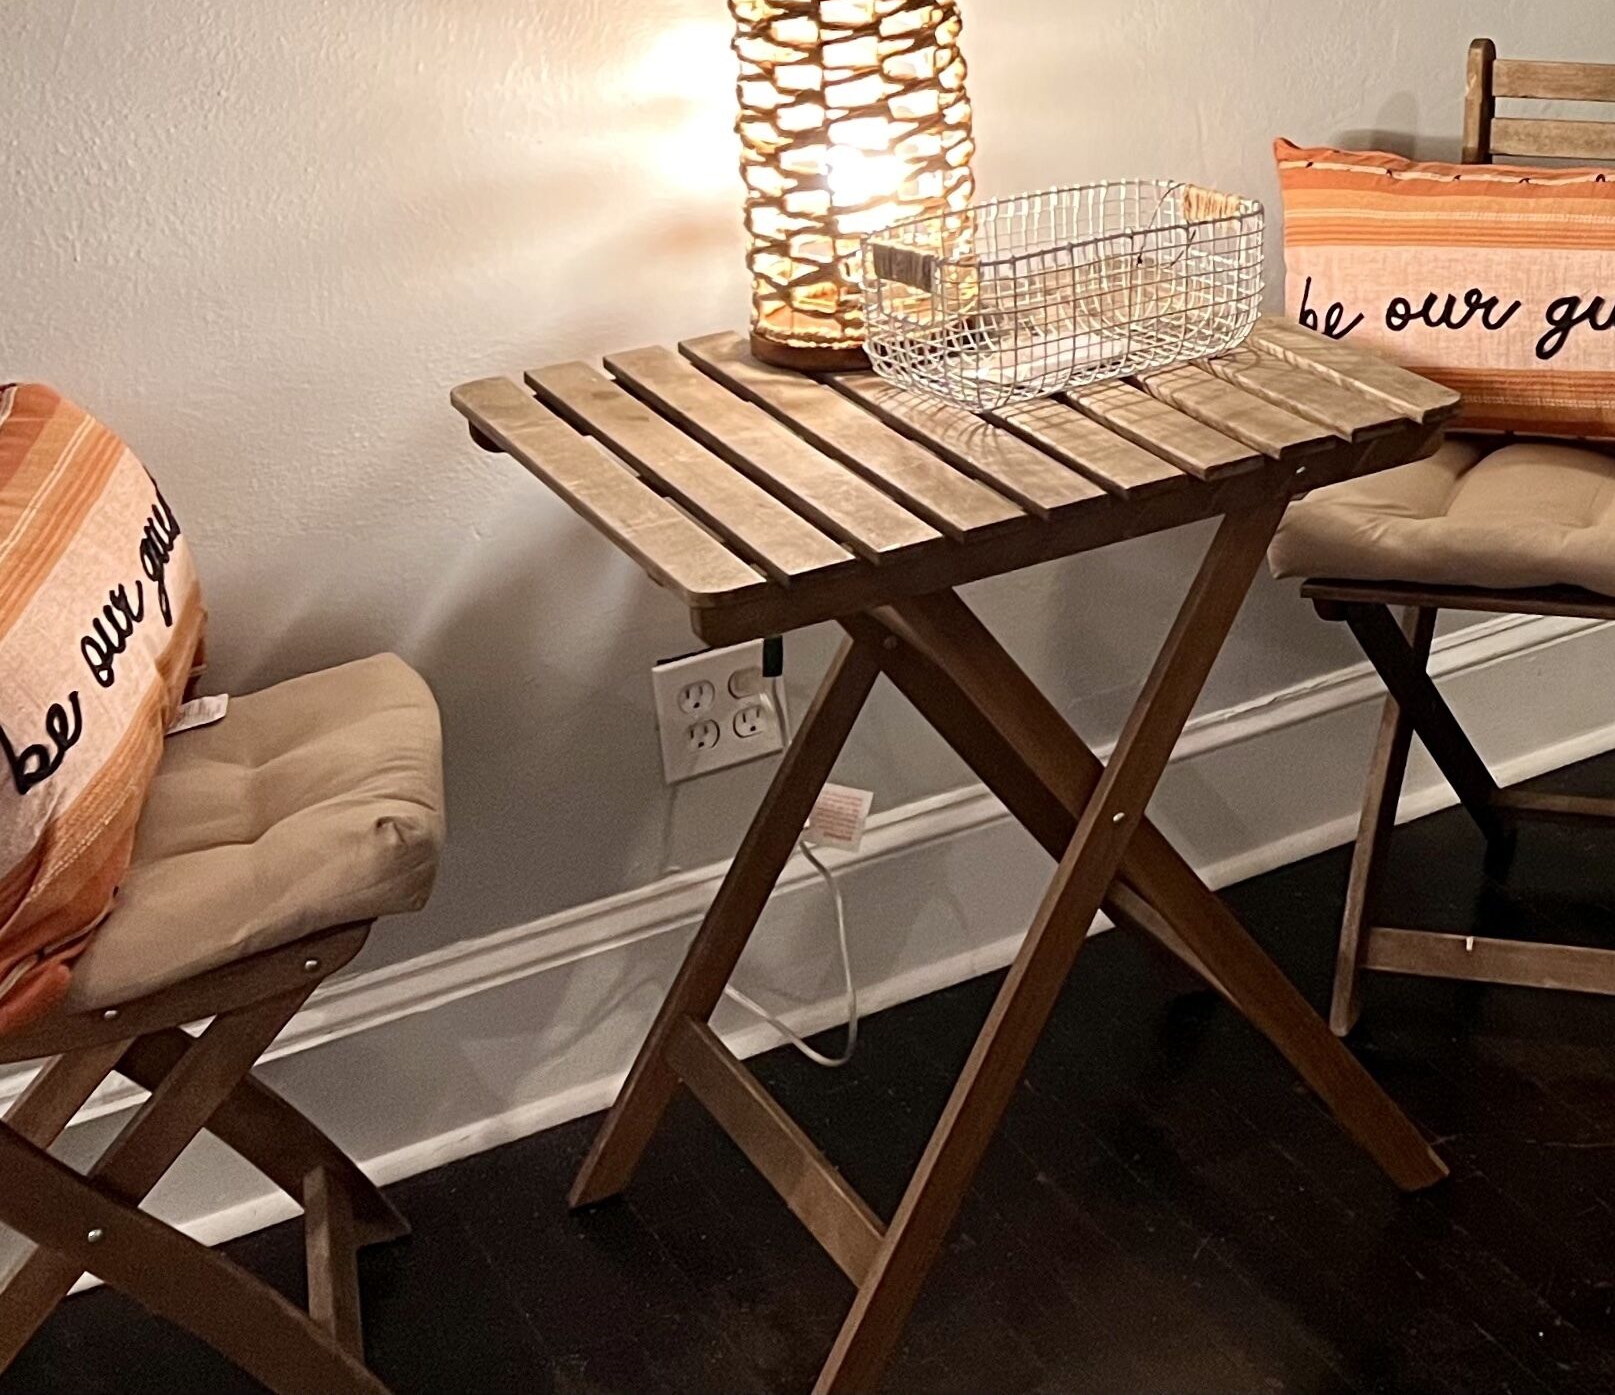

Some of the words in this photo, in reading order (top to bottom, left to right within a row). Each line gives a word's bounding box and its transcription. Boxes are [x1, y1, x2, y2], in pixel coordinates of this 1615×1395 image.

[1298, 276, 1365, 340] be
[1385, 288, 1522, 331] our
[0, 690, 82, 796] be
[80, 580, 144, 688] our
[139, 466, 182, 628] gue
